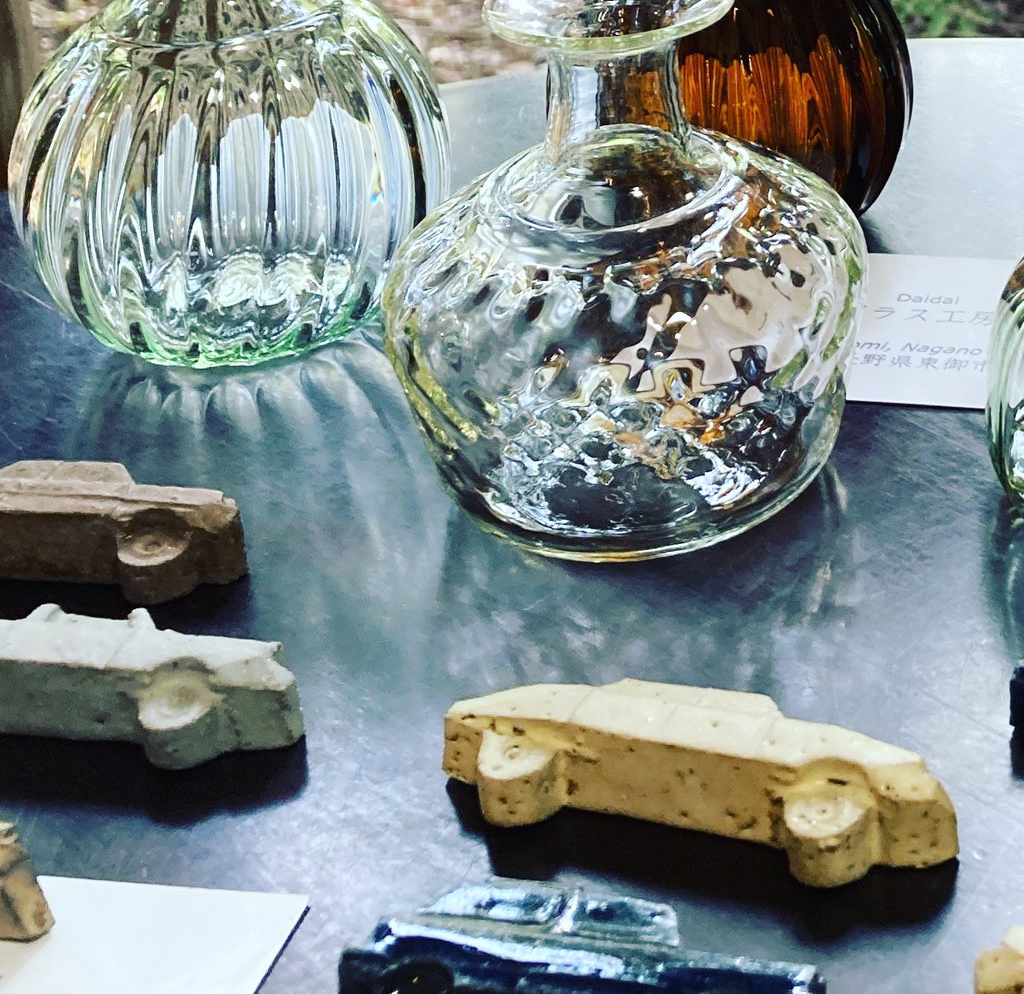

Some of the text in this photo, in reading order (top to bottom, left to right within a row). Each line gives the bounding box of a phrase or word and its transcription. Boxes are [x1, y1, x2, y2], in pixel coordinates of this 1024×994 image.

[897, 293, 960, 305] Daidai
[863, 305, 995, 327] ラス工房
[901, 342, 982, 357] Nagano
